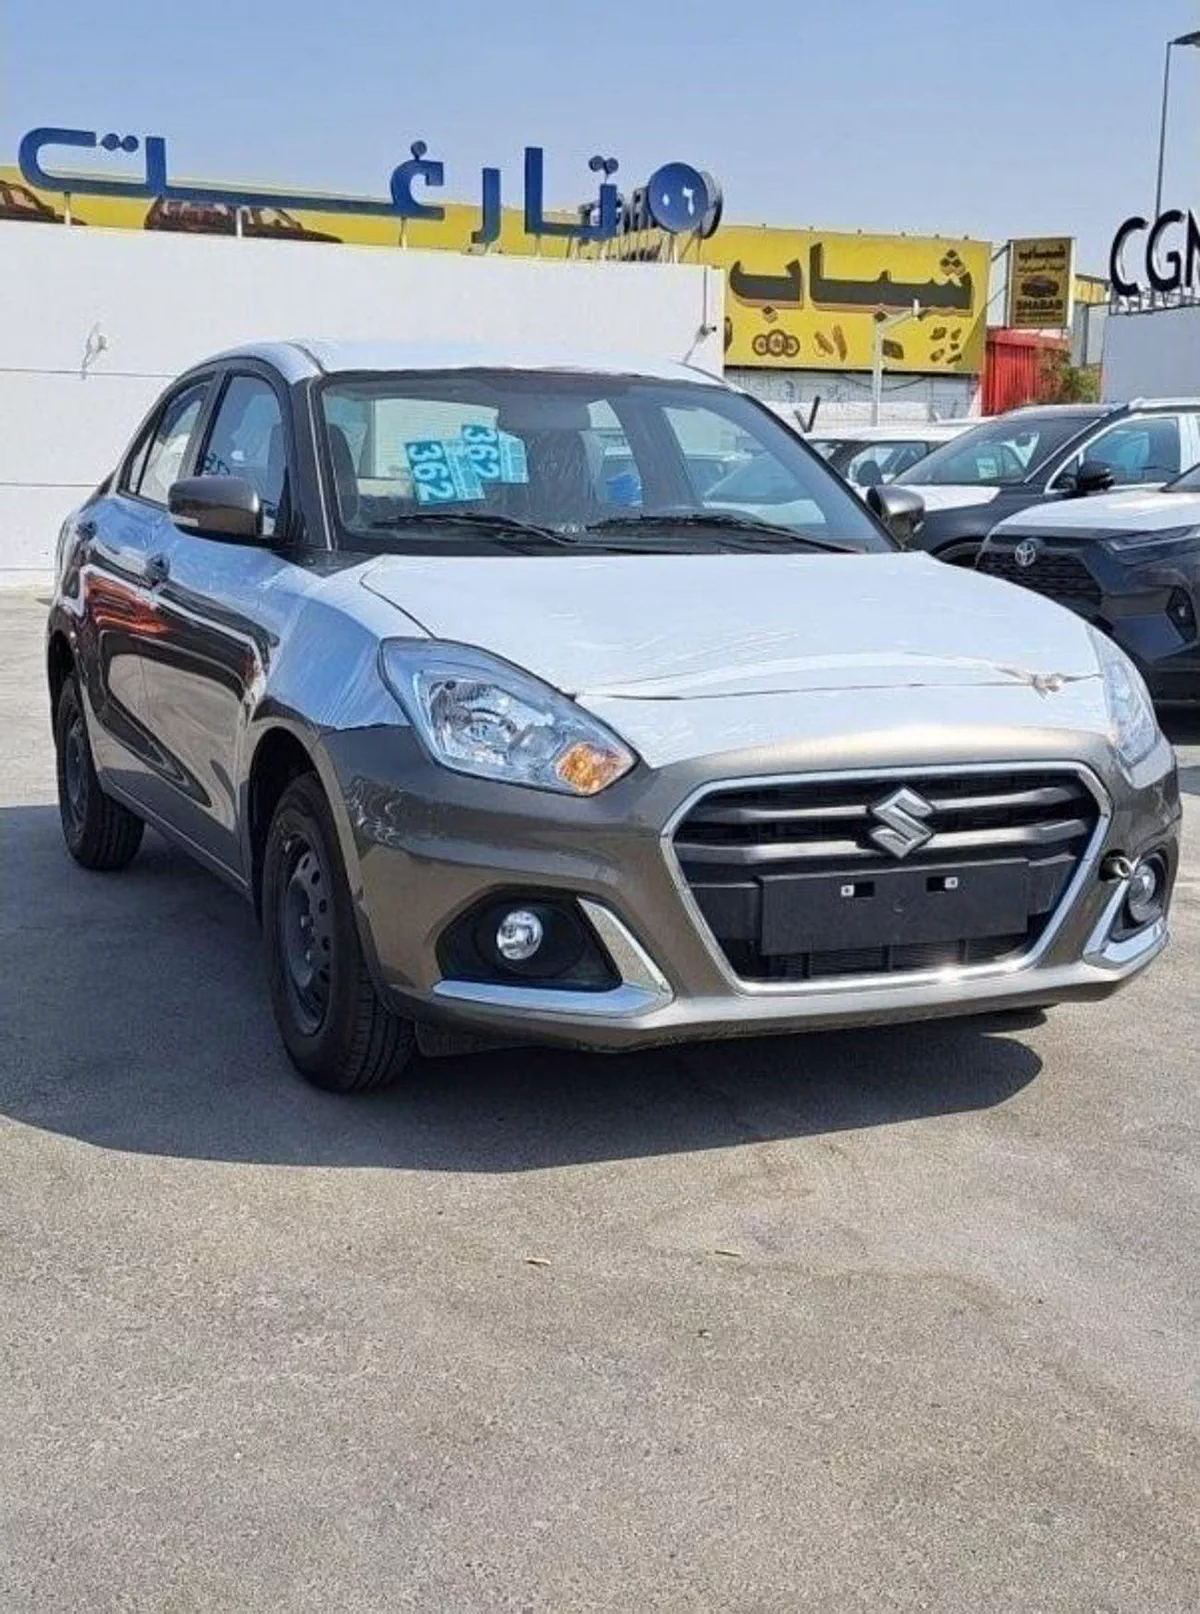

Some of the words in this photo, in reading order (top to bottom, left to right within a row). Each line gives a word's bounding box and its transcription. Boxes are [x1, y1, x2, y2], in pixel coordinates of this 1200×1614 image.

[729, 241, 972, 323] شباب
[408, 444, 455, 501] 362
[463, 427, 500, 479] 362
